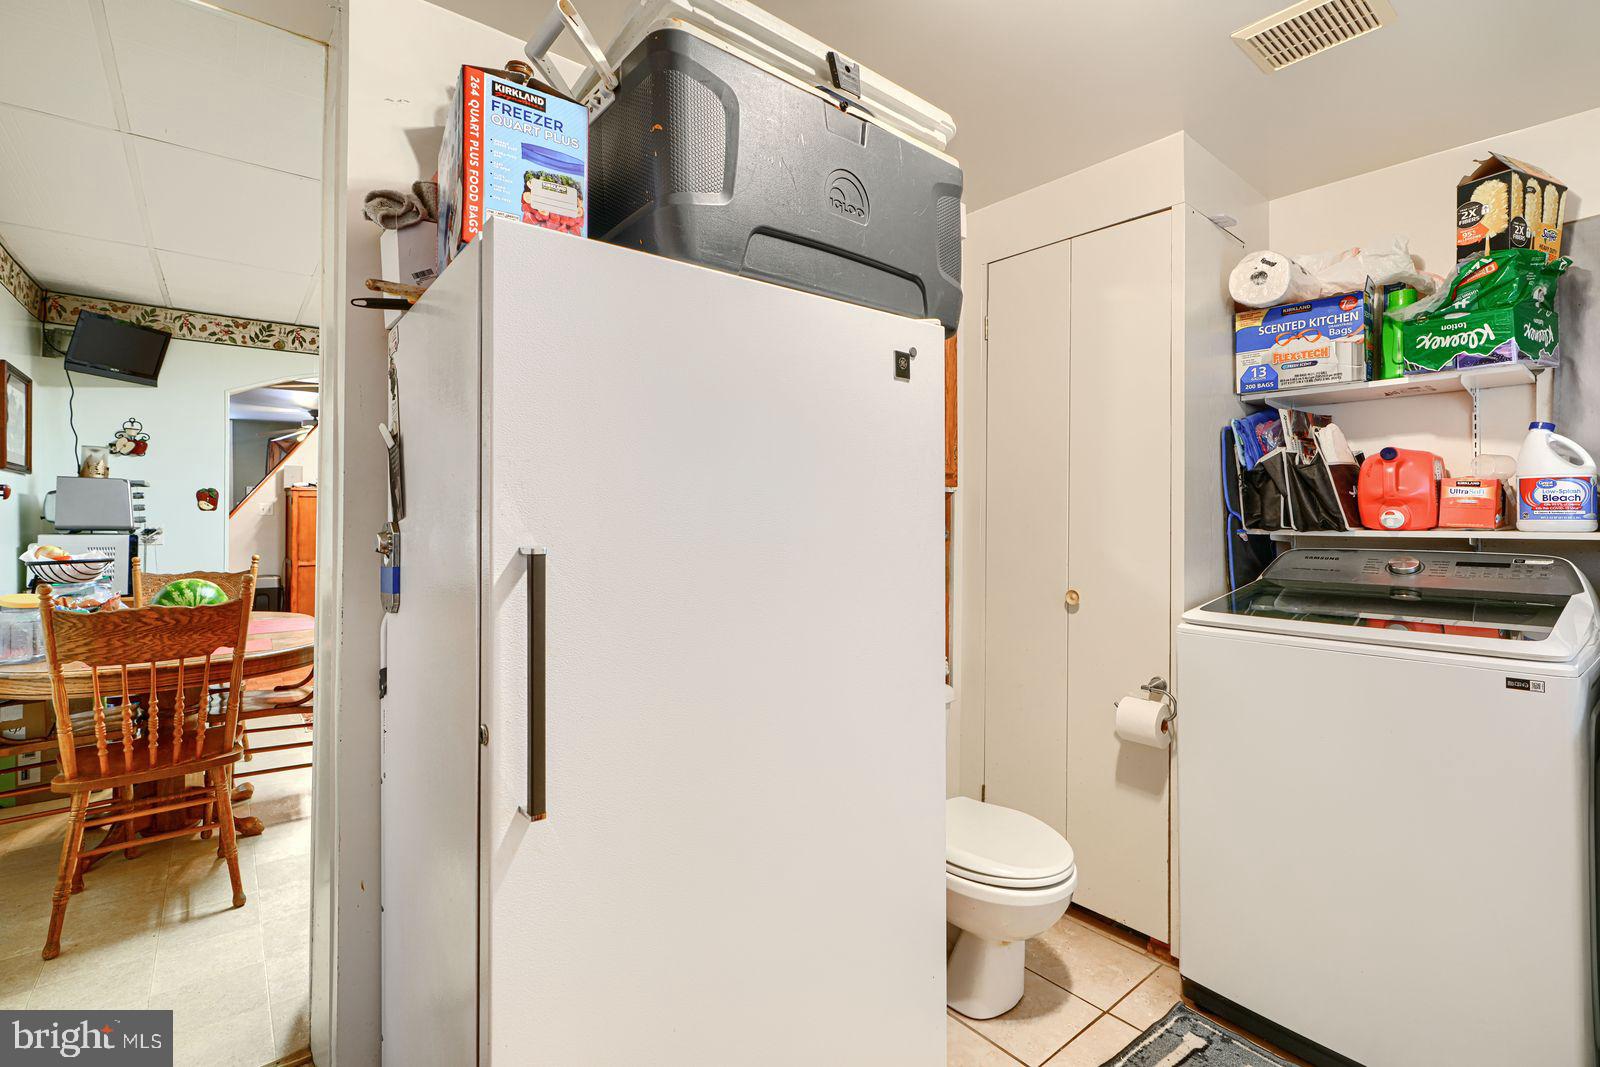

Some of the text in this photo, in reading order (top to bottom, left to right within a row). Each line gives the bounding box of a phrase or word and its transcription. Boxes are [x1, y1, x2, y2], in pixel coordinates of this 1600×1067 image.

[494, 82, 545, 106] KIRKLAND
[491, 99, 564, 133] FREEZER
[491, 113, 580, 149] QUART PLUS
[468, 75, 480, 234] 264 QUART PLUS FOOD BAGS
[1461, 208, 1477, 220] 2X
[1514, 225, 1525, 235] 2X
[1282, 304, 1311, 313] KIRKLAND
[1258, 312, 1359, 336] SCENTED KITCHEN
[1329, 327, 1352, 336] Bags
[1440, 321, 1467, 331] lotion
[1523, 322, 1555, 348] Kleenex
[1415, 323, 1496, 350] Kleenex
[1251, 366, 1267, 378] 13
